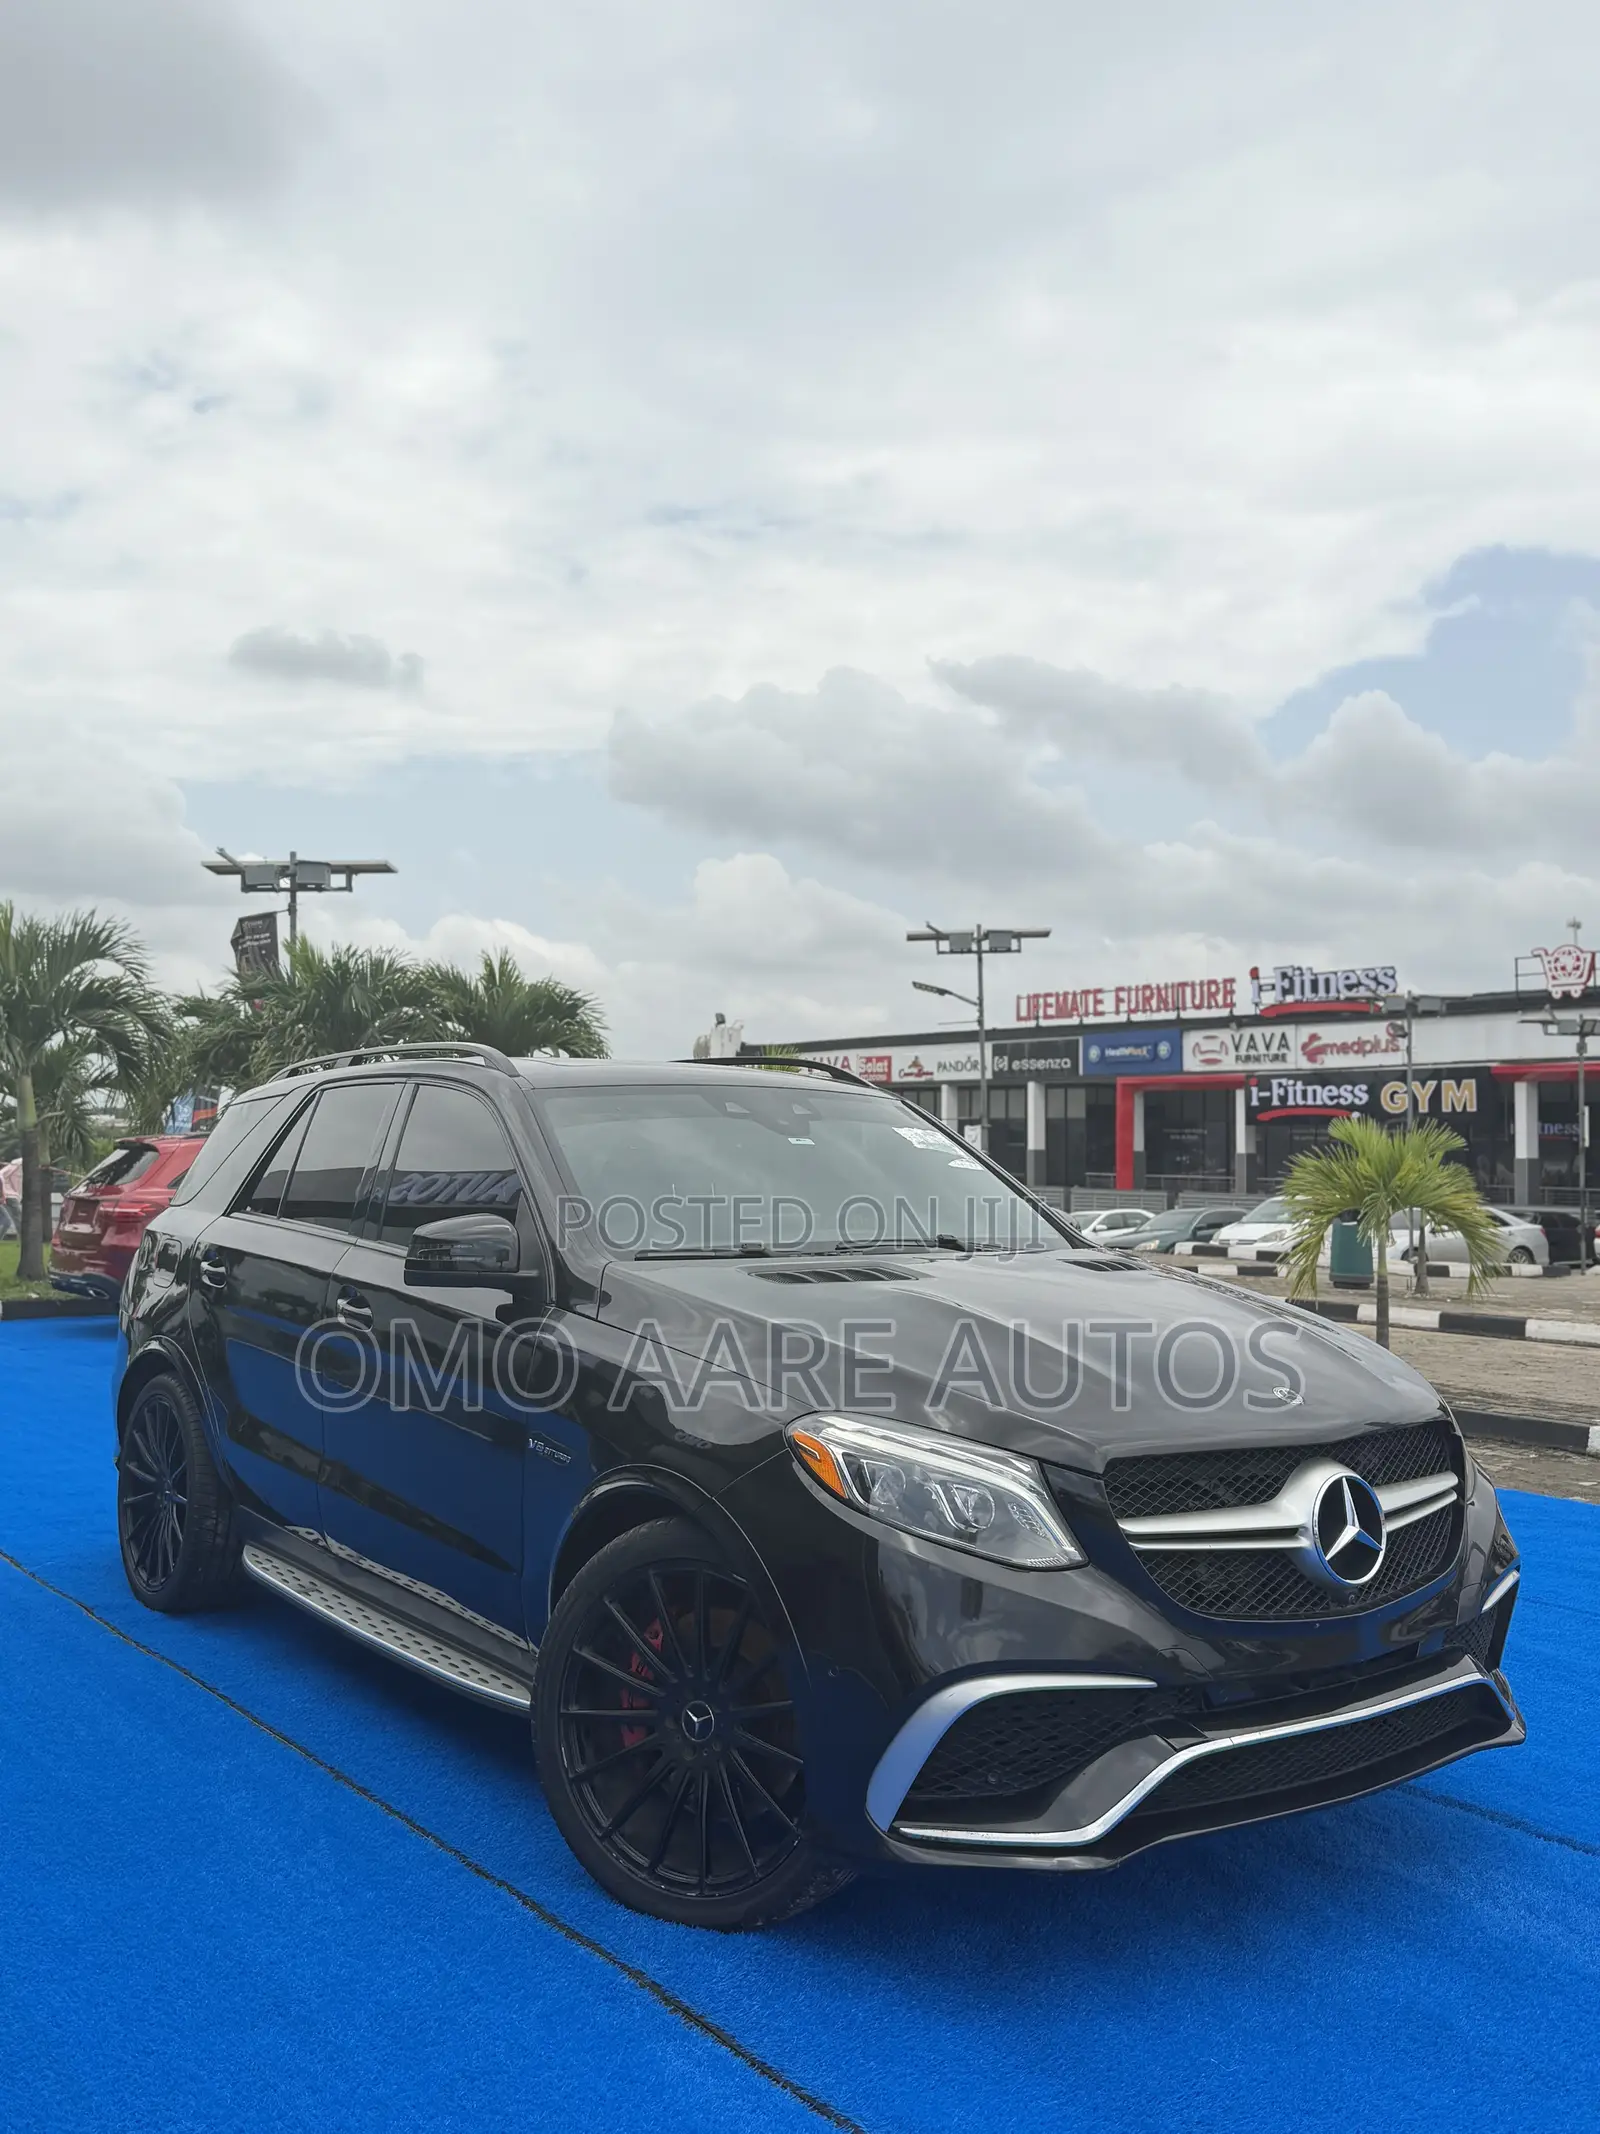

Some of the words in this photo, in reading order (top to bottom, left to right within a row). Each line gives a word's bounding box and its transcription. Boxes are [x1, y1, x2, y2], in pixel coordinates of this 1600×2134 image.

[1249, 965, 1398, 1003] i-Fitness
[1016, 988, 1105, 1021] LIFEMATE
[1115, 978, 1236, 1015] FURNITURE
[1231, 1032, 1291, 1053] VAVA
[1323, 1034, 1401, 1058] medplus
[1011, 1057, 1072, 1071] essenza
[1234, 1053, 1287, 1065] FURNITURE
[1250, 1077, 1369, 1107] i-Fitness
[1380, 1079, 1477, 1114] GYM
